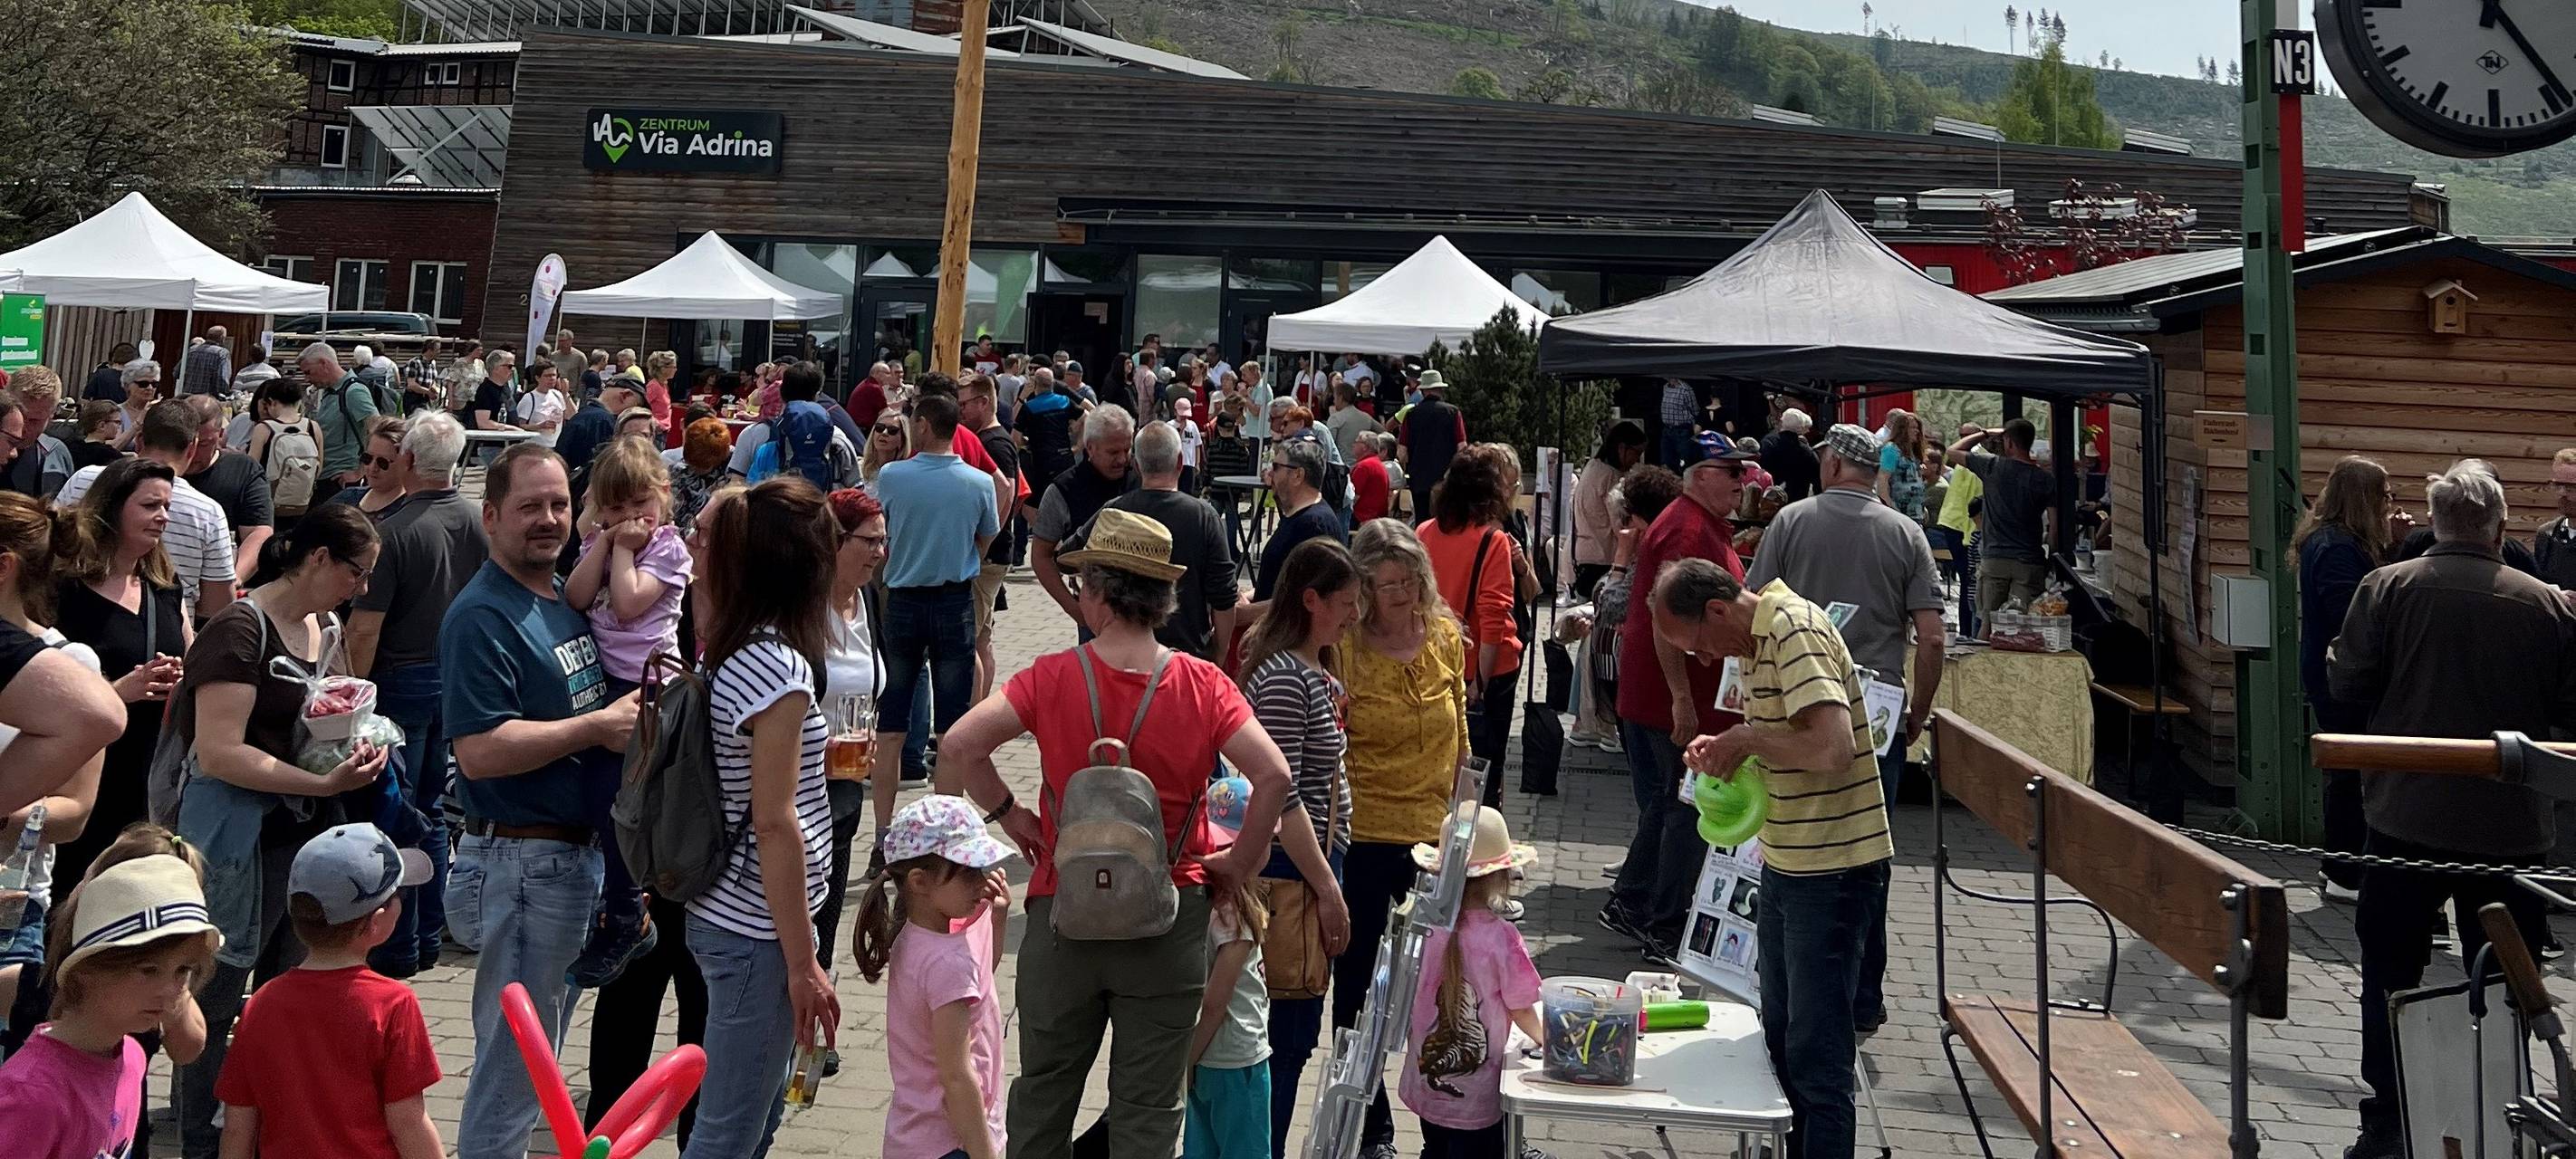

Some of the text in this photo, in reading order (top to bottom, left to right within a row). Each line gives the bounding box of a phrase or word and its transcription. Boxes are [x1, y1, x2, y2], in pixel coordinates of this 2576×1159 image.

[2273, 39, 2310, 84] N3
[639, 118, 710, 131] ZENTRUM
[639, 129, 773, 157] Via Adrina
